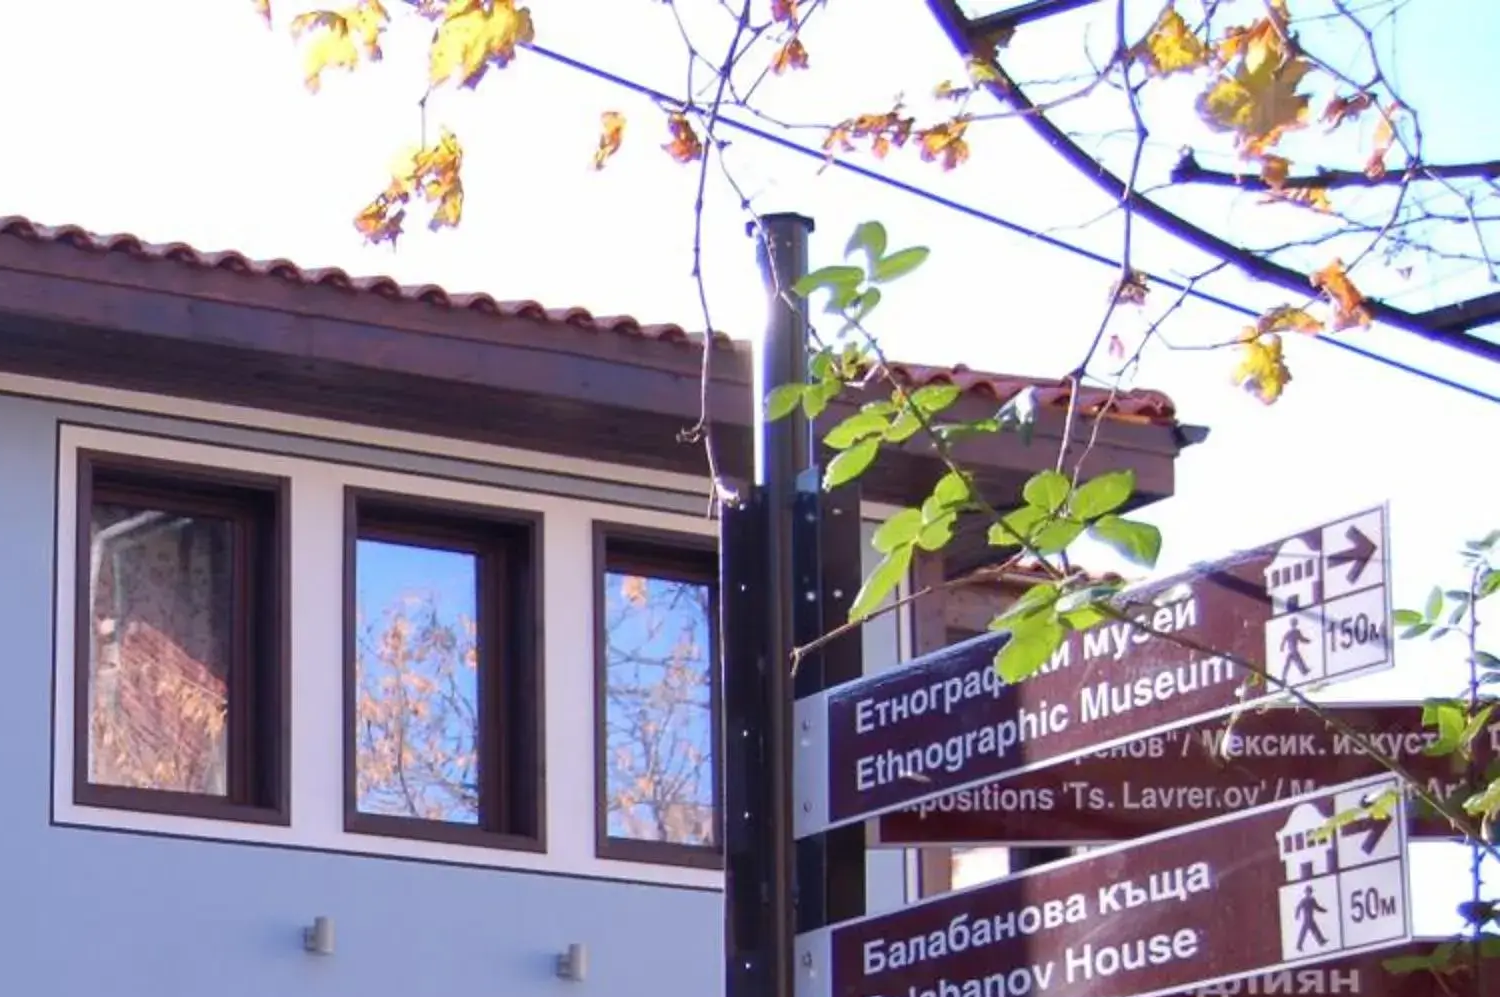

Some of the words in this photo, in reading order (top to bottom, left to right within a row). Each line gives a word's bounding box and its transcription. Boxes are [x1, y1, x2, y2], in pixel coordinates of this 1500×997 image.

[856, 701, 1069, 791] Ethnographic
[1080, 654, 1235, 723] Museum
[863, 898, 1087, 975] Балабанова
[1097, 861, 1211, 916] къща
[1350, 886, 1396, 923] 50м
[1064, 927, 1199, 984] House
